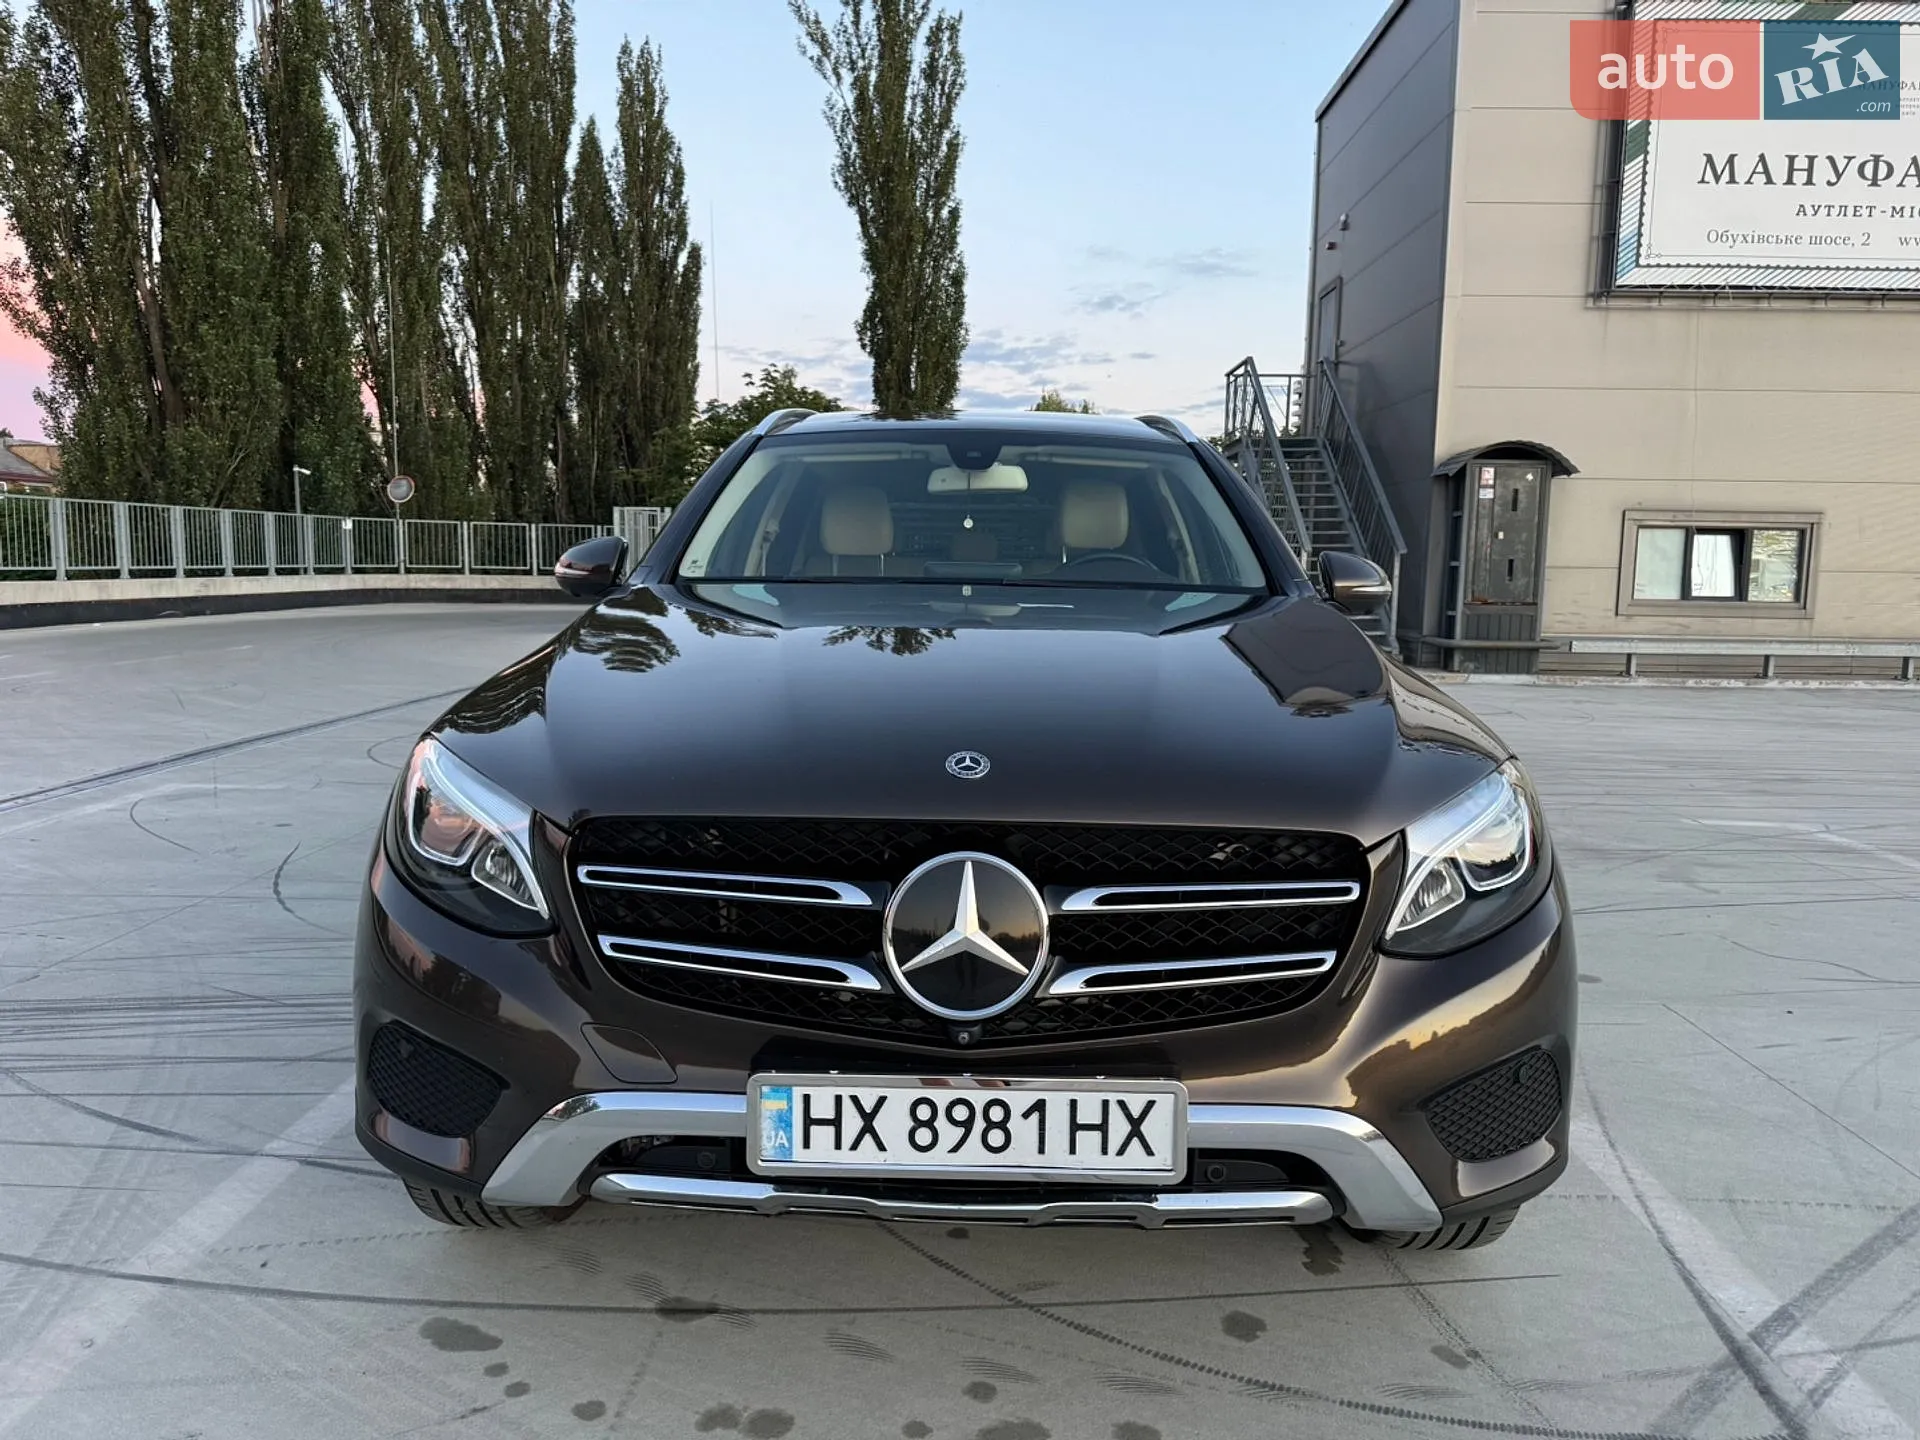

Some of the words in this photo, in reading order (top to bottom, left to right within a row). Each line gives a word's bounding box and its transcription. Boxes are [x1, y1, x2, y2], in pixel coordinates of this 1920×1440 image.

[1795, 204, 1920, 218] АУТЛЕТ-МІ
[1706, 229, 1803, 249] Обухівське
[1809, 234, 1855, 247] шосе,
[1861, 231, 1871, 246] 2
[802, 1093, 888, 1152] HX
[908, 1096, 1046, 1155] 8981
[1069, 1098, 1155, 1156] HX
